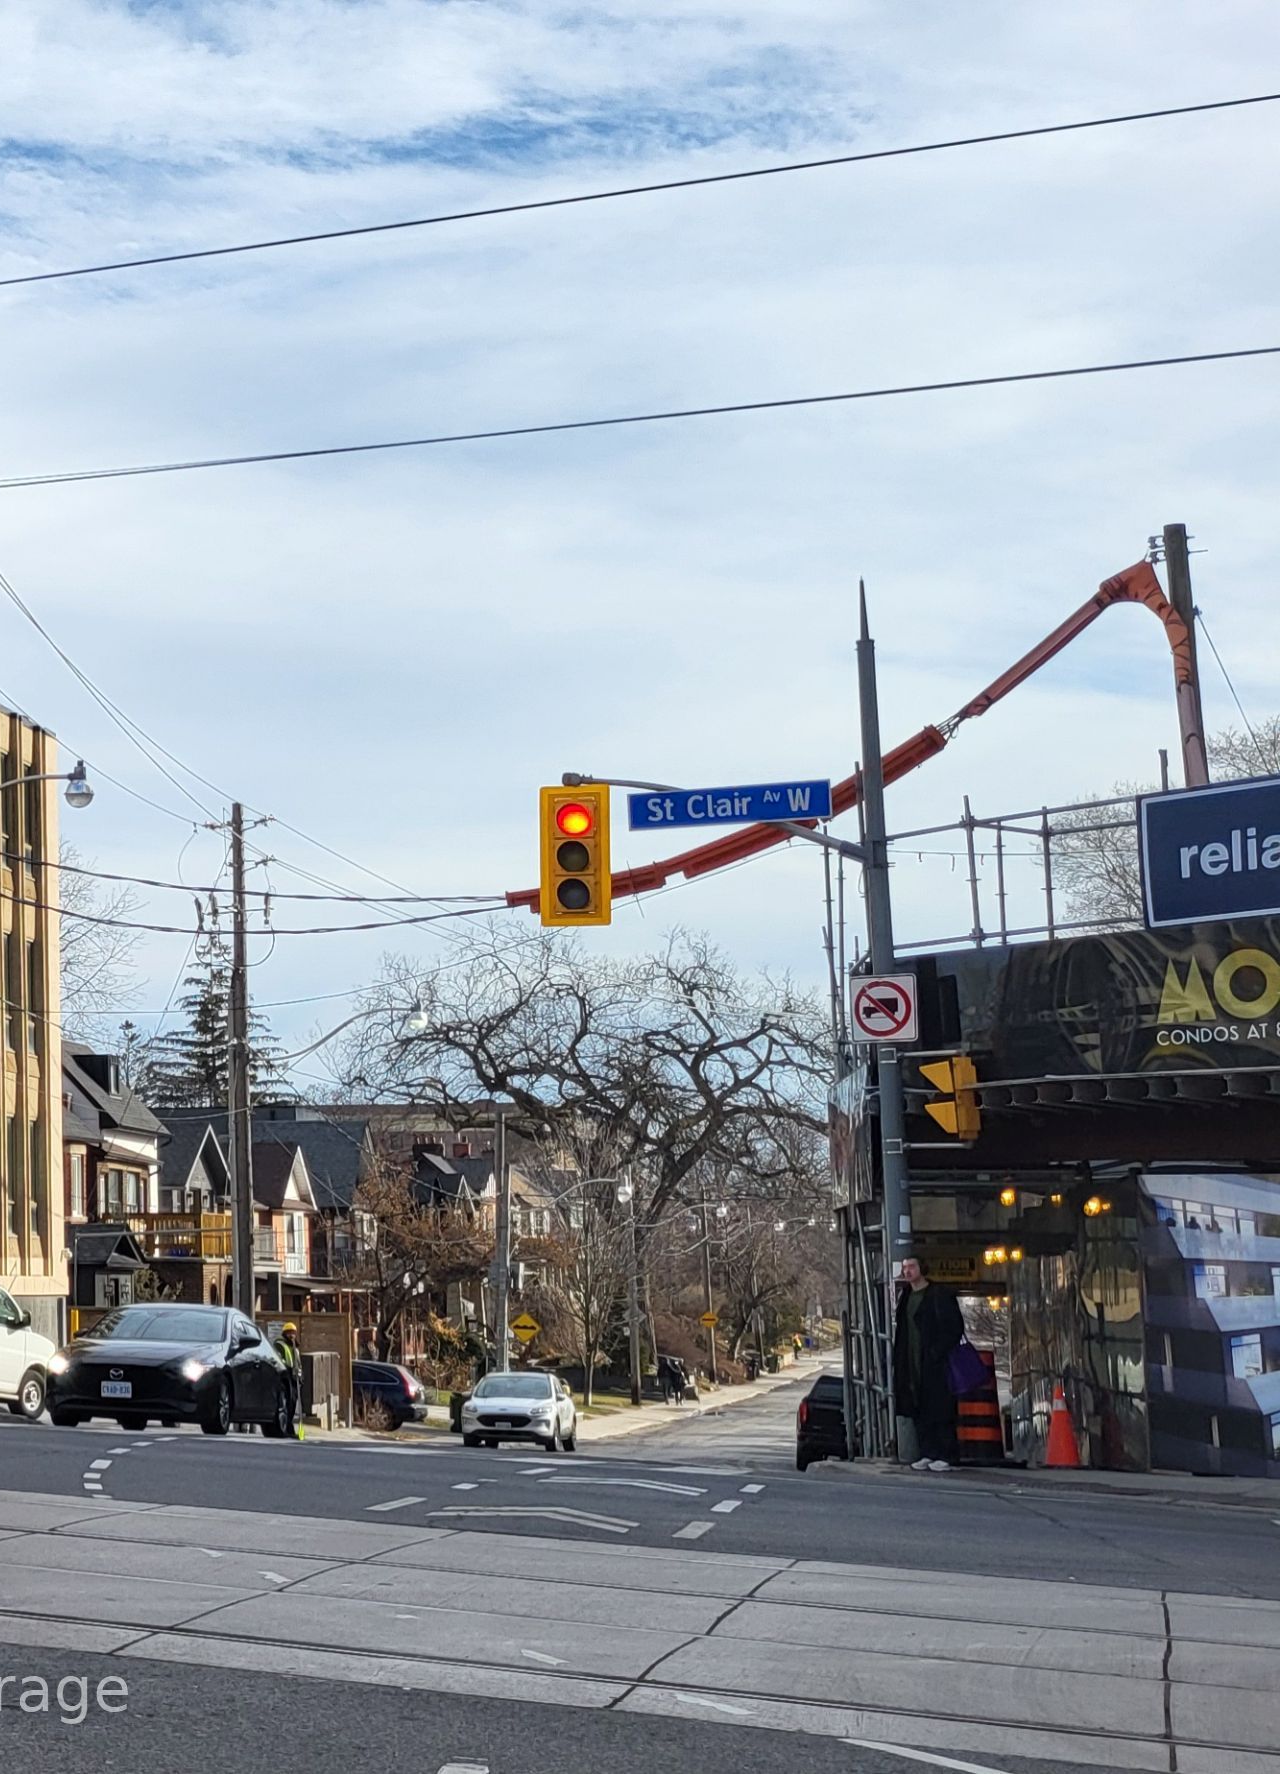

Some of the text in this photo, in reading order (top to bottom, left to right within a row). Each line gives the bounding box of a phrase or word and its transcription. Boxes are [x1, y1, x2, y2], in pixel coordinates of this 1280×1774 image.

[647, 787, 810, 822] St Clair Av W
[1157, 1026, 1239, 1046] CONDOS
[1247, 1023, 1268, 1039] AT
